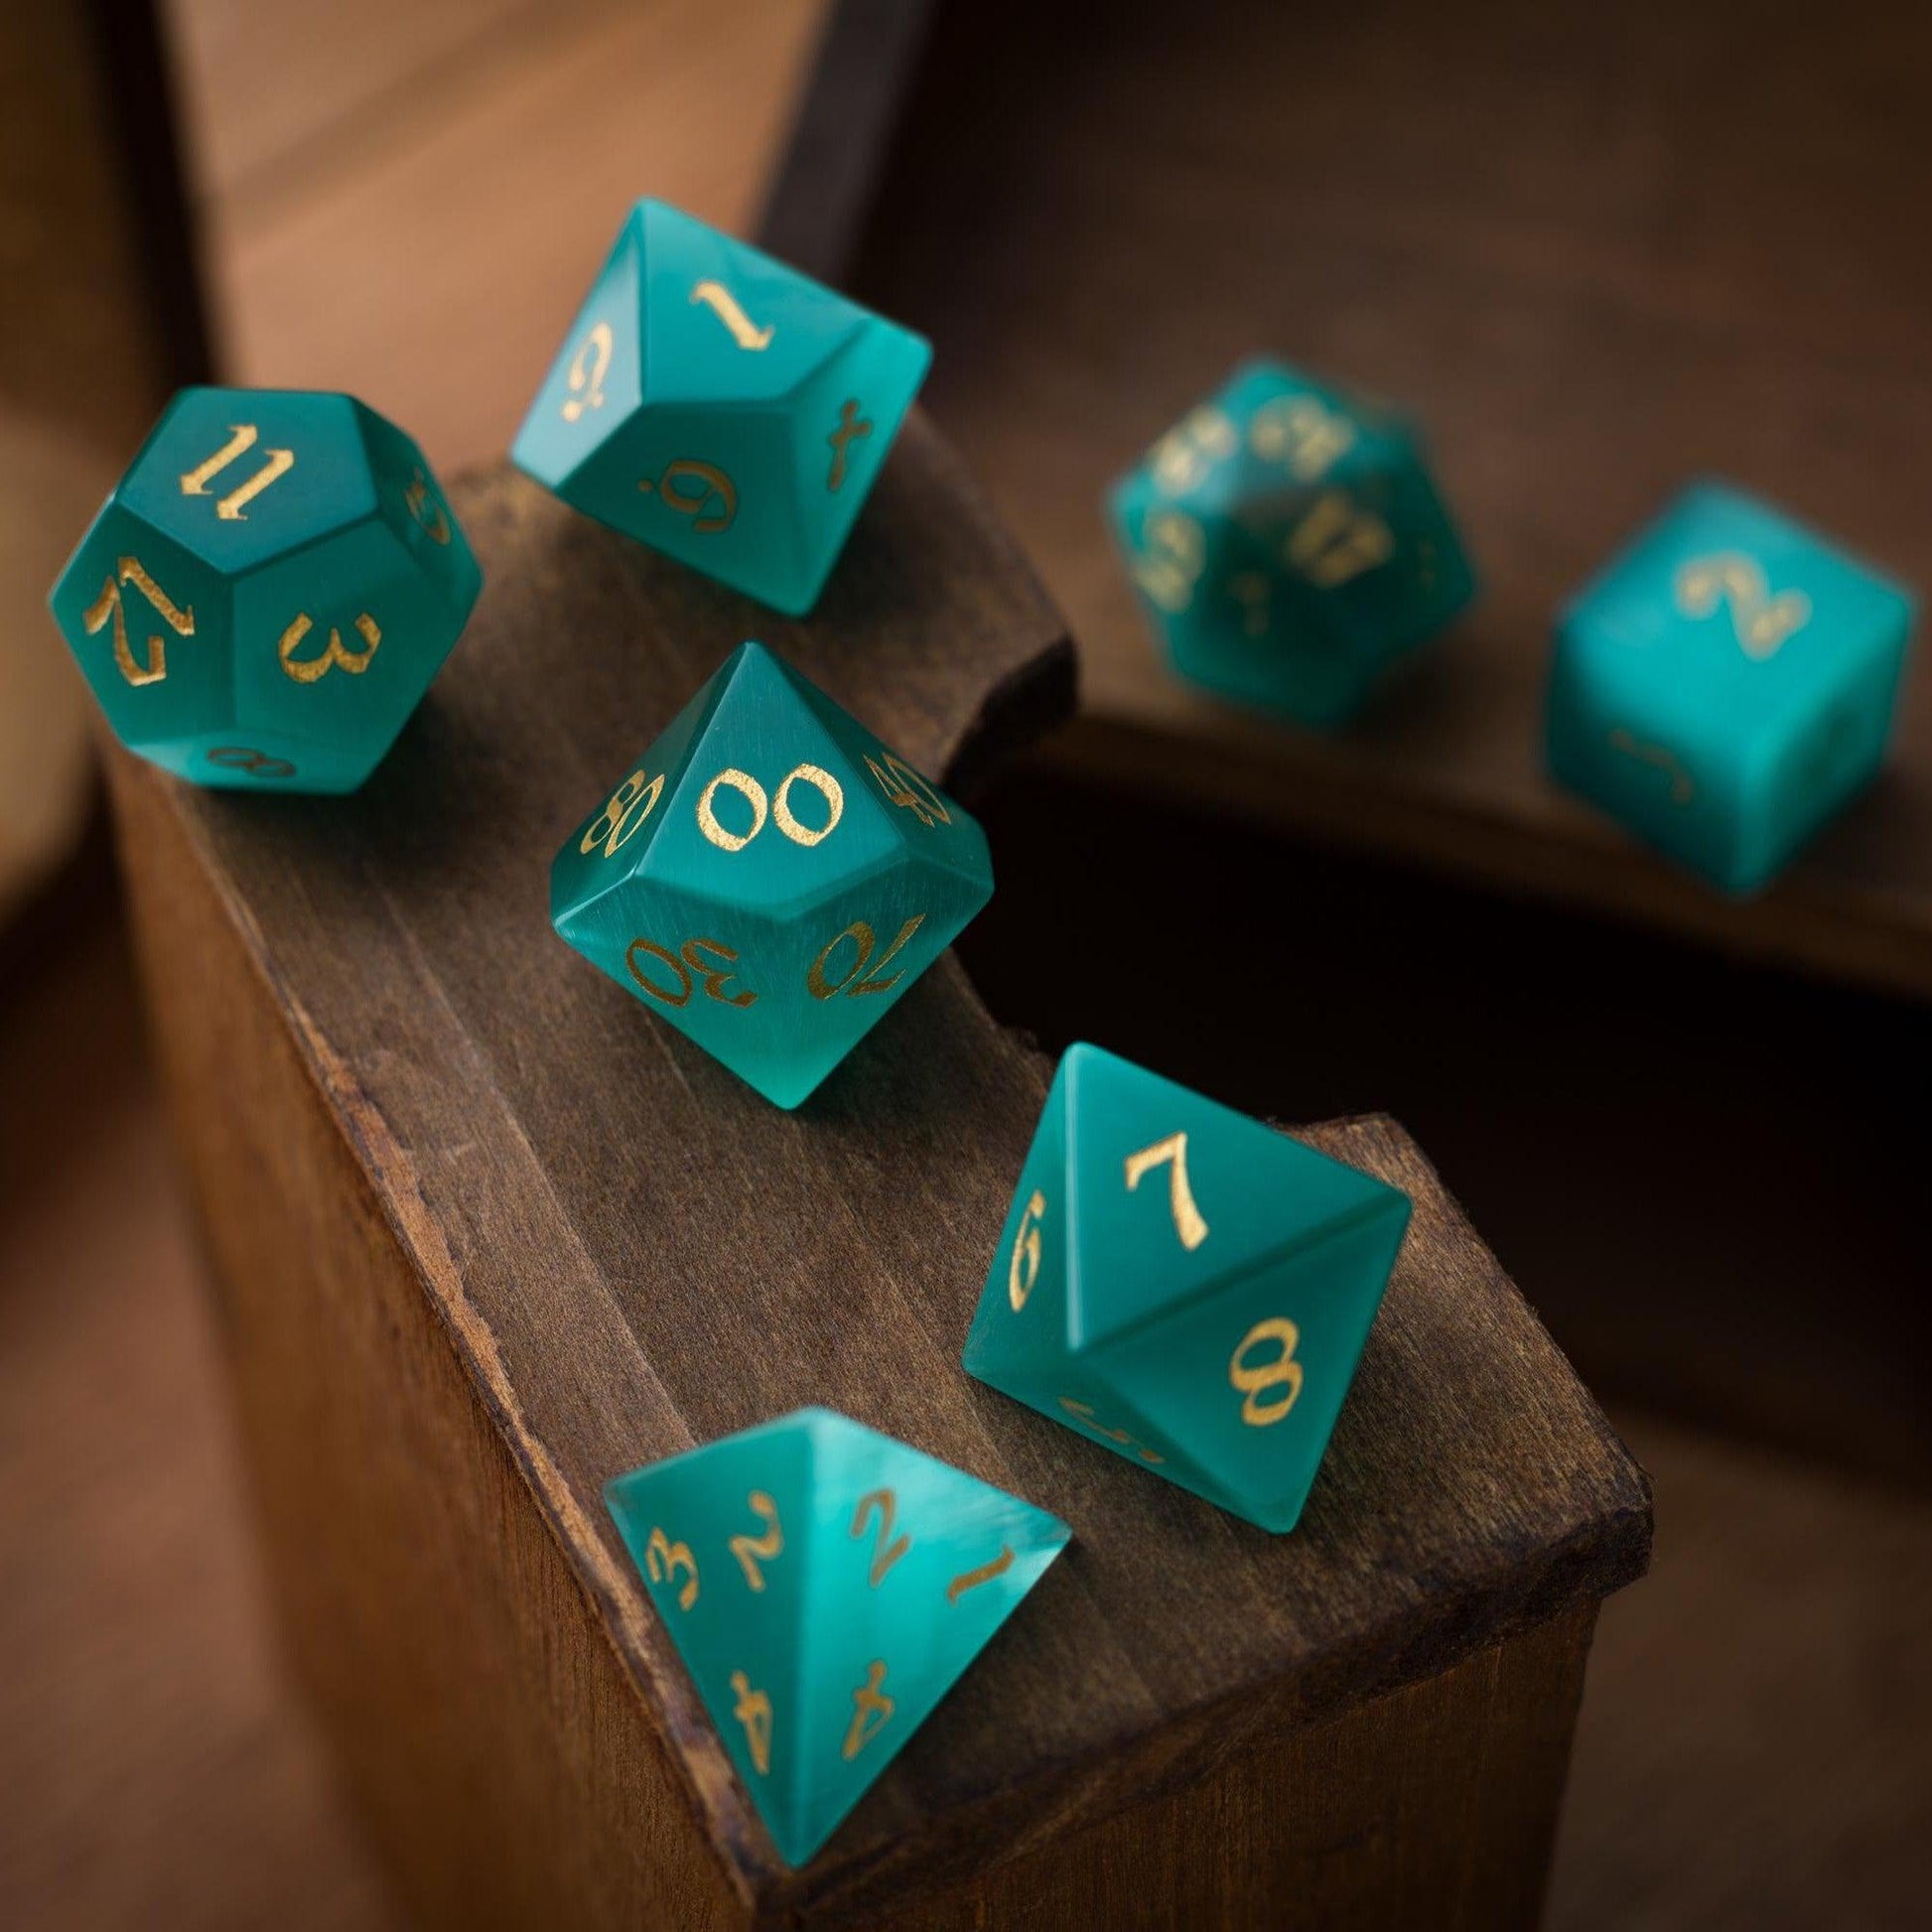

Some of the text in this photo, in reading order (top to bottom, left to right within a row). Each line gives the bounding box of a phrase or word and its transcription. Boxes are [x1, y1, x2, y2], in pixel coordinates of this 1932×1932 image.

[689, 279, 776, 351] 1
[179, 424, 295, 521] 11
[83, 556, 196, 687] 12
[277, 612, 383, 684] 3
[1674, 549, 1814, 662] 2
[579, 768, 666, 859] 80
[696, 761, 845, 852] 00
[863, 751, 952, 829] 40
[624, 937, 759, 1009] 30
[806, 912, 926, 1001] 70
[1123, 1129, 1210, 1252] 7
[1008, 1188, 1047, 1314] 6
[1227, 1315, 1305, 1428] 8
[643, 1524, 699, 1612] 3
[728, 1489, 784, 1592] 2
[849, 1486, 912, 1588] 2
[945, 1540, 1017, 1608] 1
[728, 1668, 772, 1776] 4
[840, 1659, 895, 1763] 4
